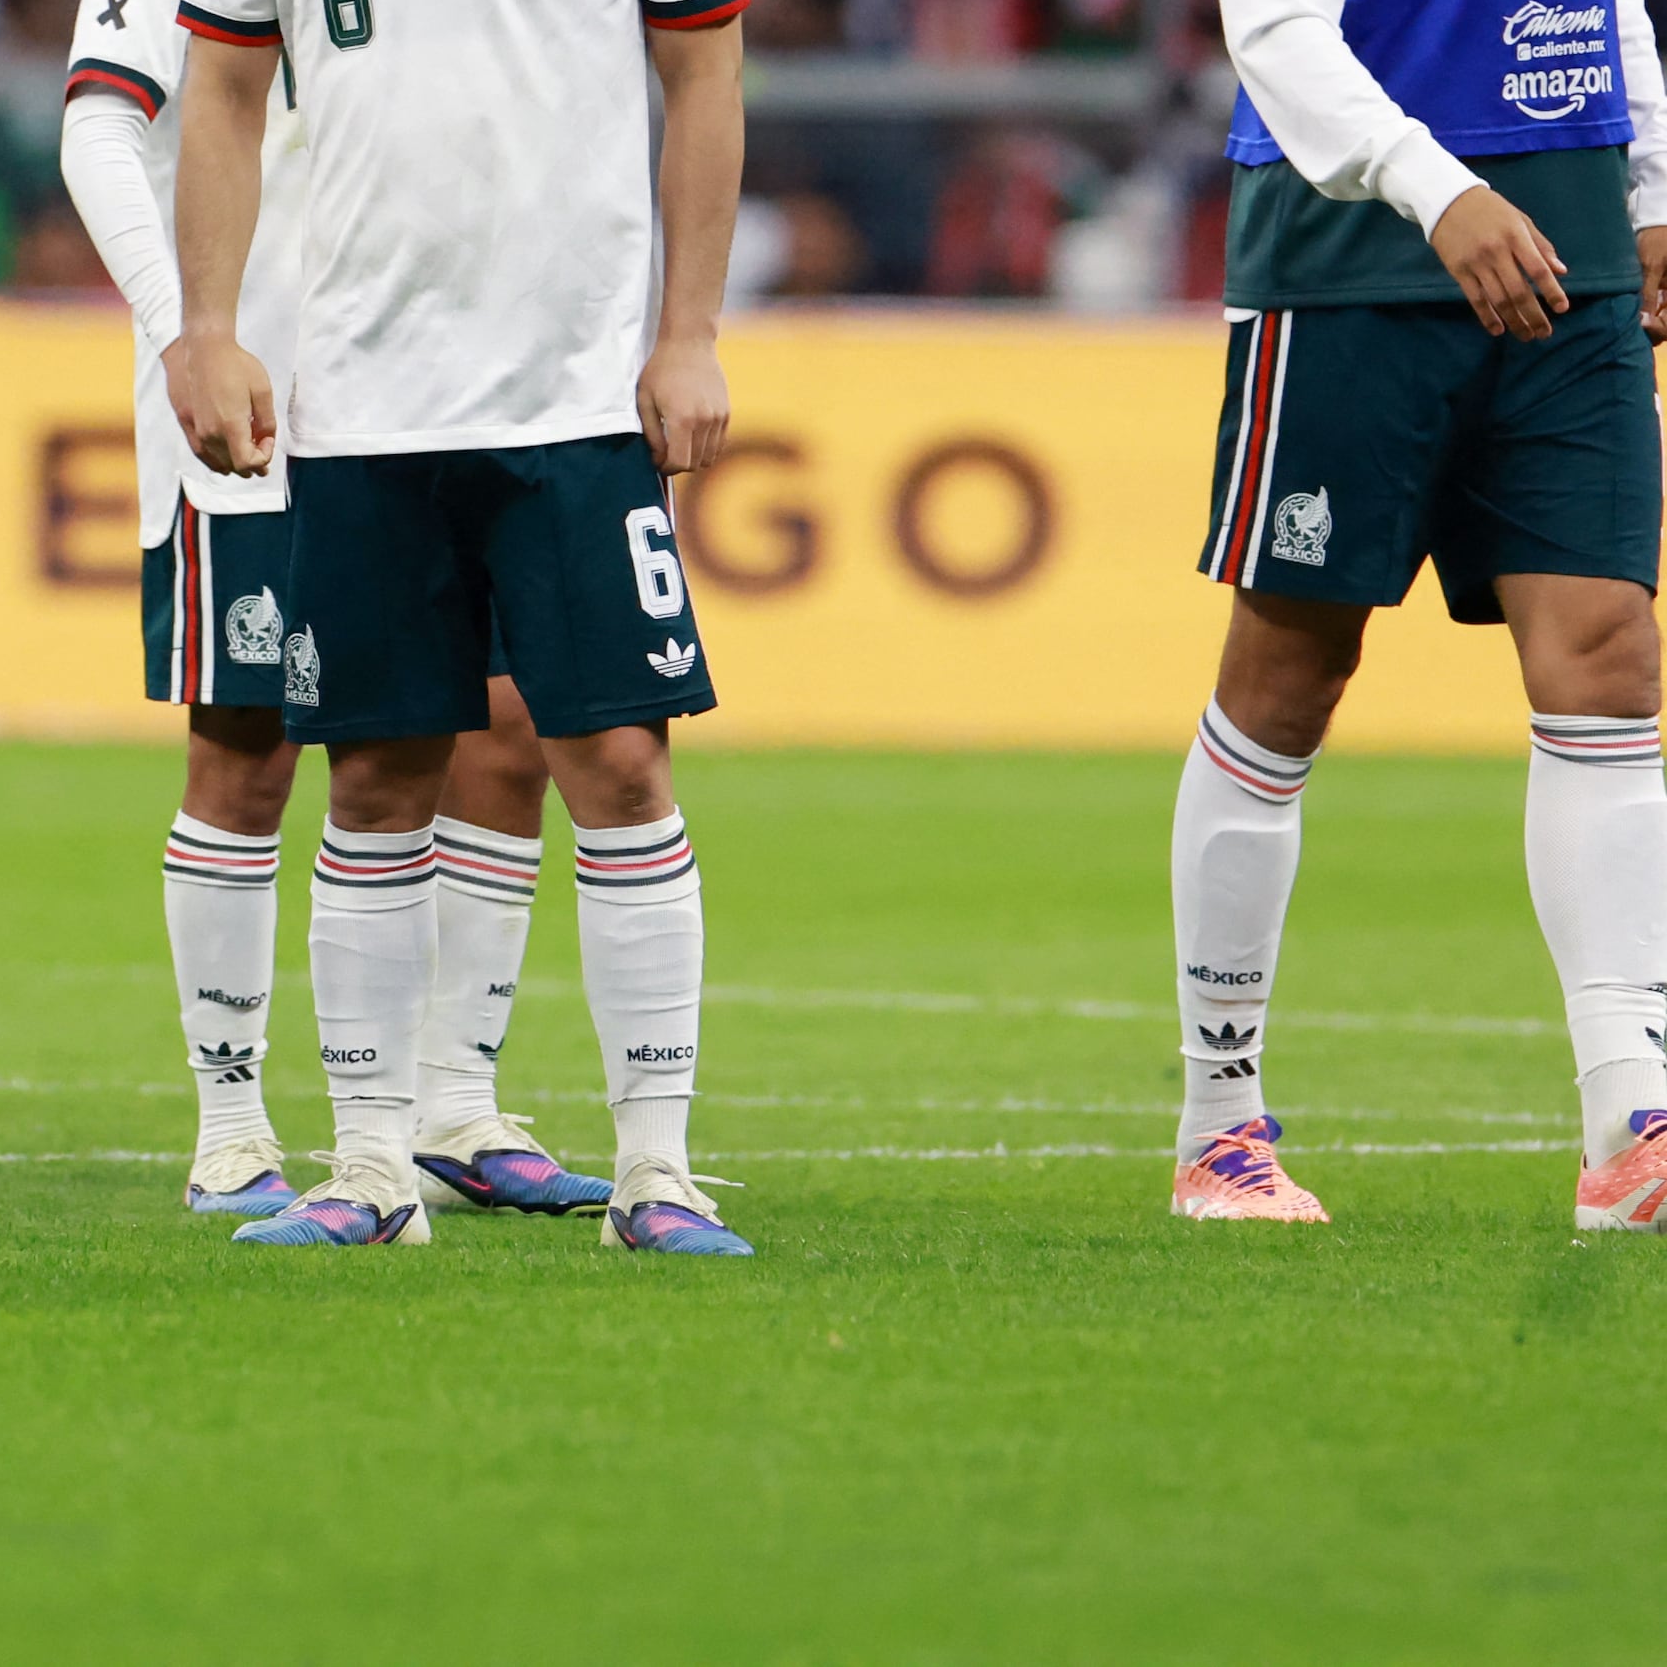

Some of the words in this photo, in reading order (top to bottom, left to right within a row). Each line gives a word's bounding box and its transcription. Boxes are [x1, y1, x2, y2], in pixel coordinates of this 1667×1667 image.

[1531, 39, 1606, 58] caliente.mx
[1501, 64, 1613, 101] amazon
[625, 505, 685, 619] 6
[1274, 544, 1322, 561] MÉXICO
[1186, 963, 1264, 987] MÉXICO
[320, 1045, 376, 1064] ÉXICO
[627, 1045, 693, 1063] MÉXICO
